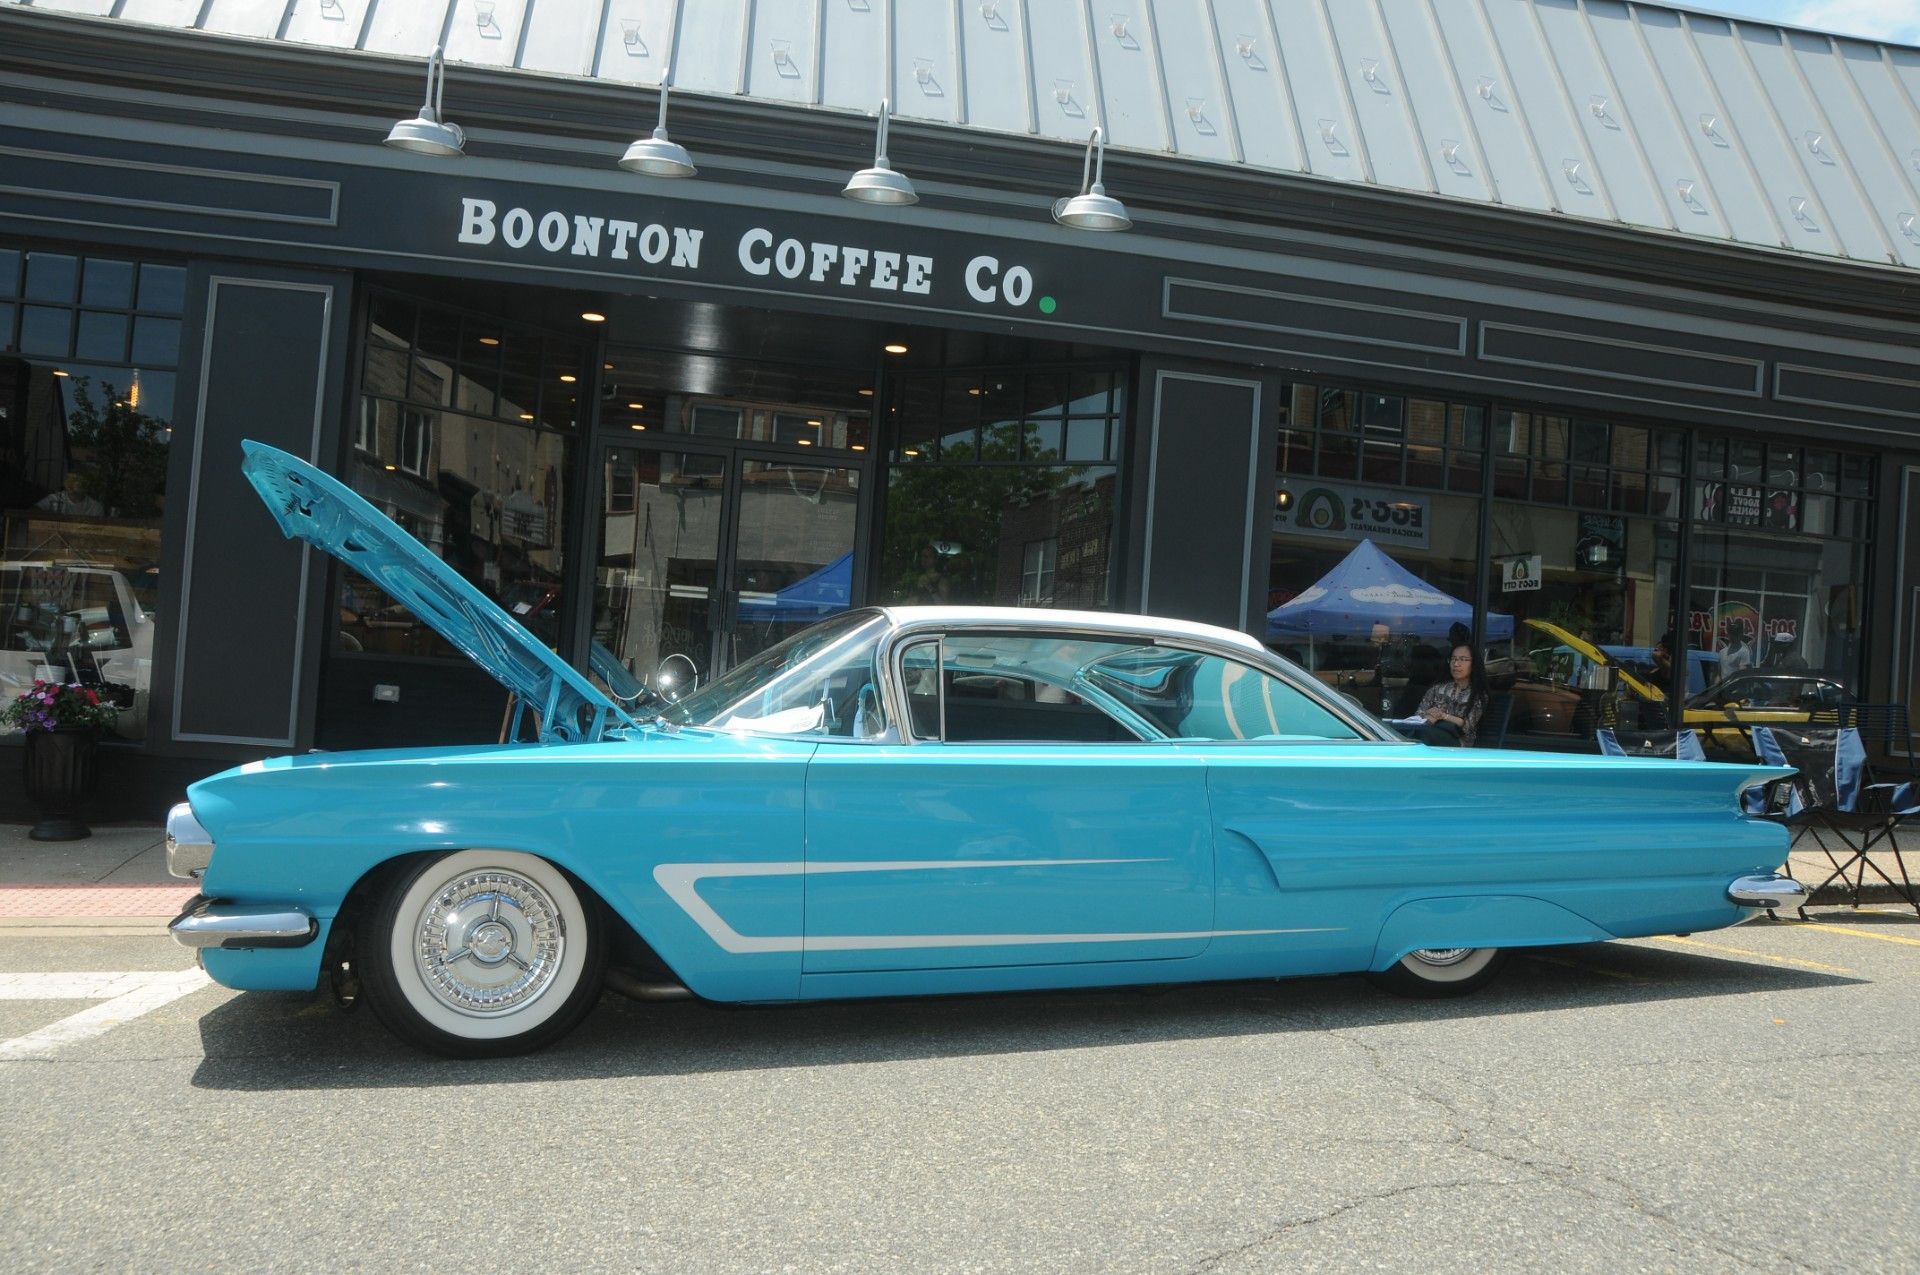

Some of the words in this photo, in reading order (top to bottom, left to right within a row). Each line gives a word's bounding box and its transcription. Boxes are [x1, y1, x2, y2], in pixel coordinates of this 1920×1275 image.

[458, 197, 704, 269] BOONTON
[738, 227, 933, 295] COFFEE
[964, 255, 1056, 314] CO.
